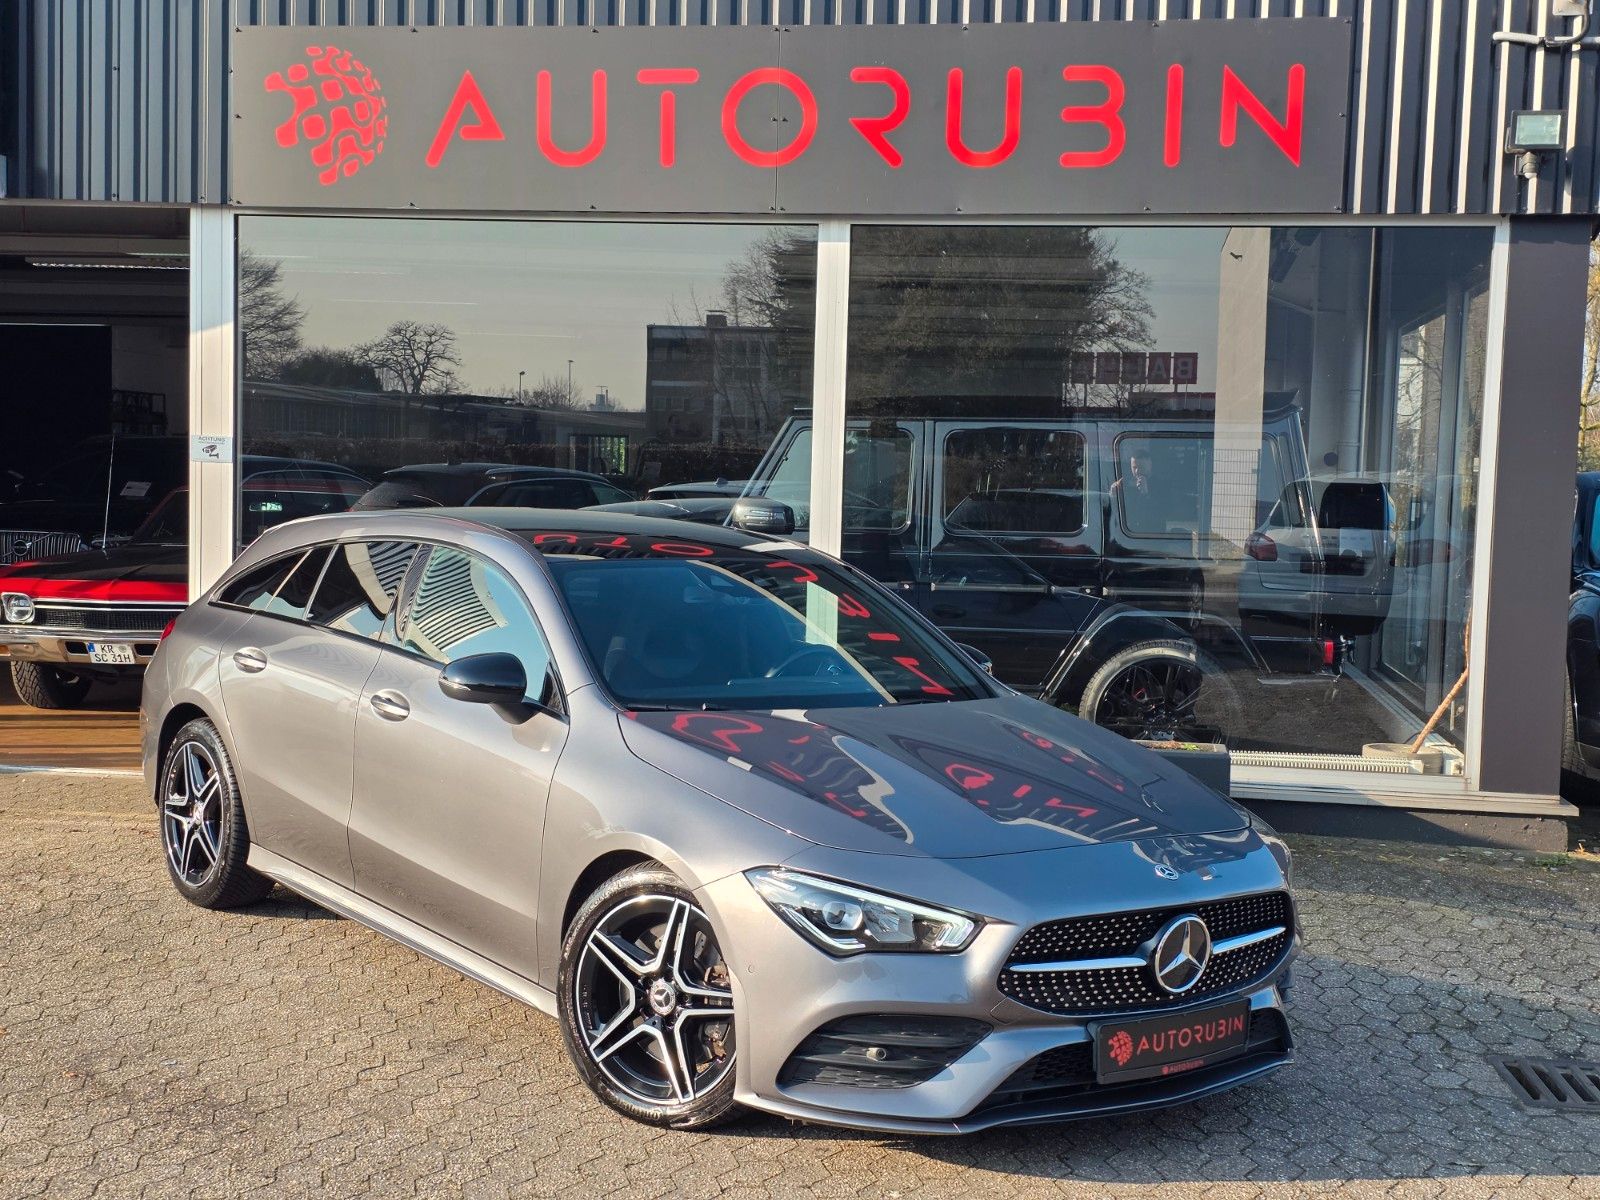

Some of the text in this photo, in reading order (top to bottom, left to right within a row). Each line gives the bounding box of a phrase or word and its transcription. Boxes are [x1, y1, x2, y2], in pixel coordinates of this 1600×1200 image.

[425, 62, 1305, 169] AUTORUBIN
[94, 653, 131, 663] SC 31H
[100, 644, 115, 654] KR
[1137, 1014, 1244, 1056] AUTORUBIN
